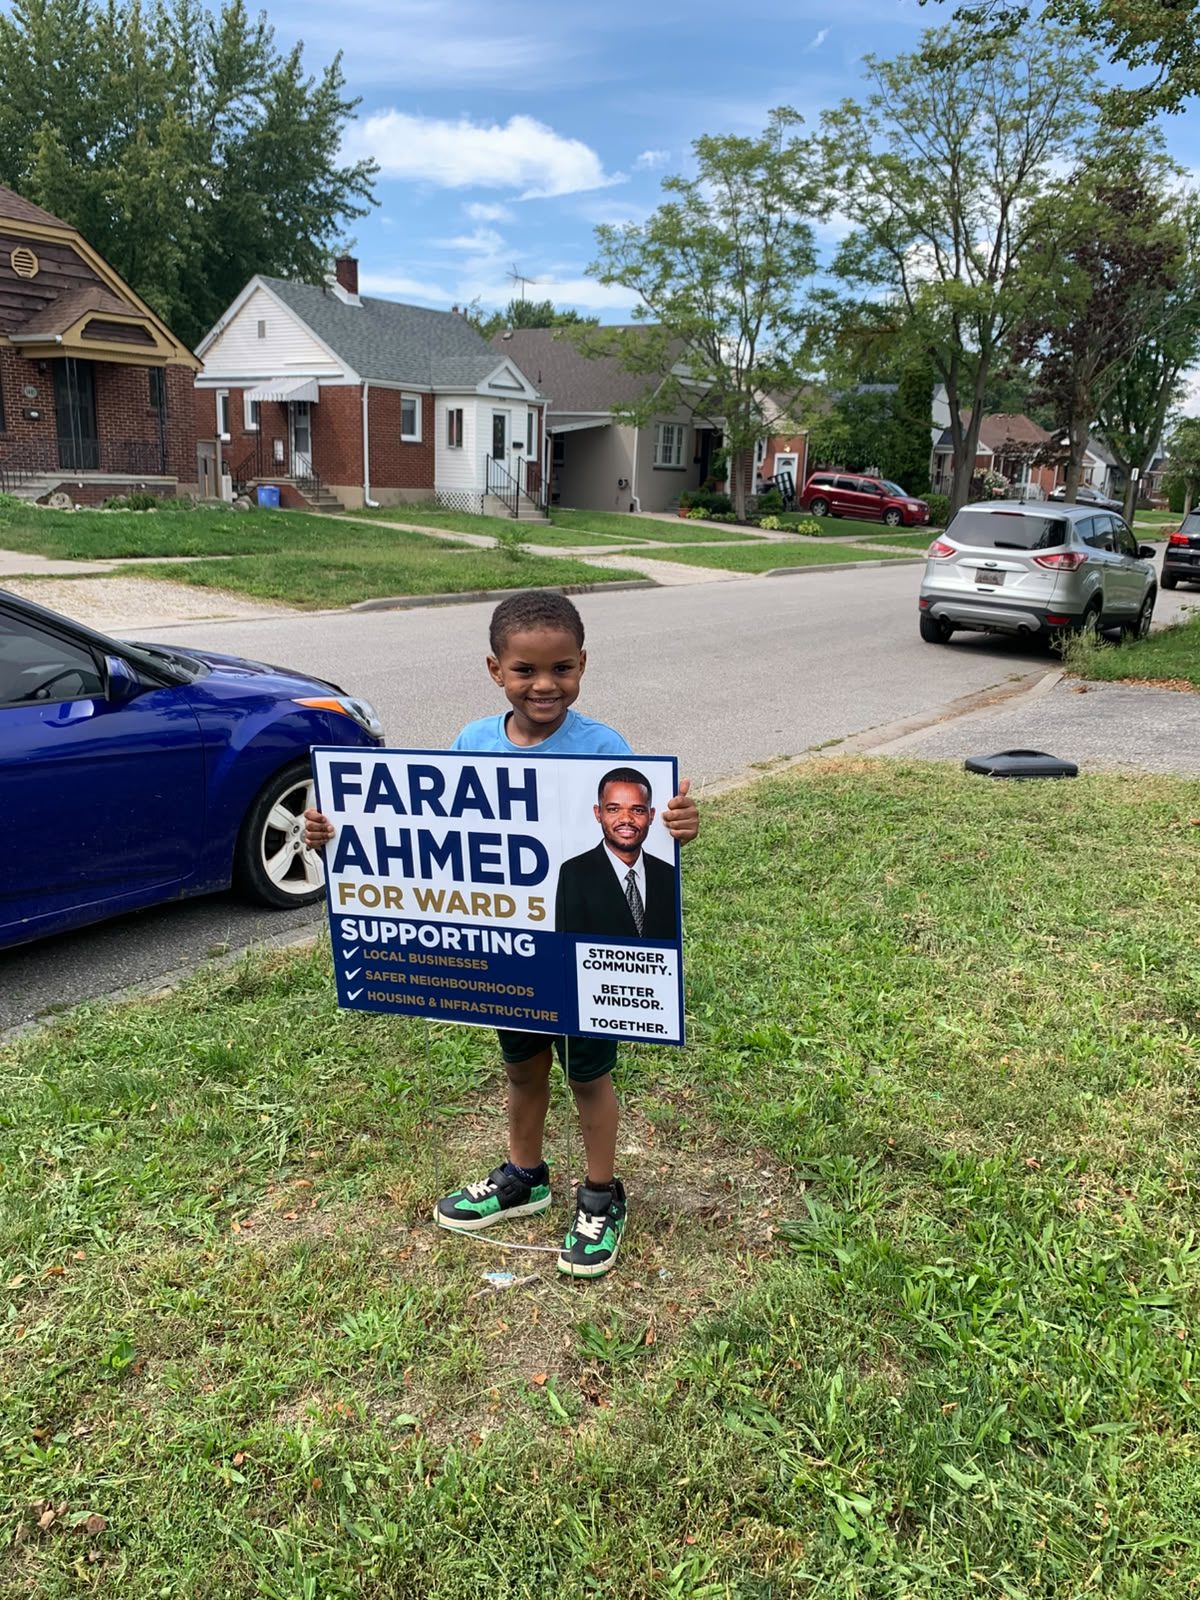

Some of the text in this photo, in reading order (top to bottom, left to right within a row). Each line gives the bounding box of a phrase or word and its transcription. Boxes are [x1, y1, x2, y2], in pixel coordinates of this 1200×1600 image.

[329, 762, 539, 822] FARAH
[332, 825, 549, 886] AHMED
[338, 882, 546, 921] FOR WARD 5
[341, 918, 535, 956] SUPPORTING
[363, 949, 488, 970] LOCAL BUSINESSES
[588, 948, 665, 963] STRONGER
[582, 960, 672, 976] COMMUNITY.
[365, 971, 534, 997] SAFER NEIGHBOURHOODS
[601, 984, 654, 997] BETTER
[368, 992, 558, 1022] HOUSING & INFRASTRUCTURE
[593, 995, 664, 1010] WINDSOR.
[590, 1018, 668, 1034] TOGETHER.
